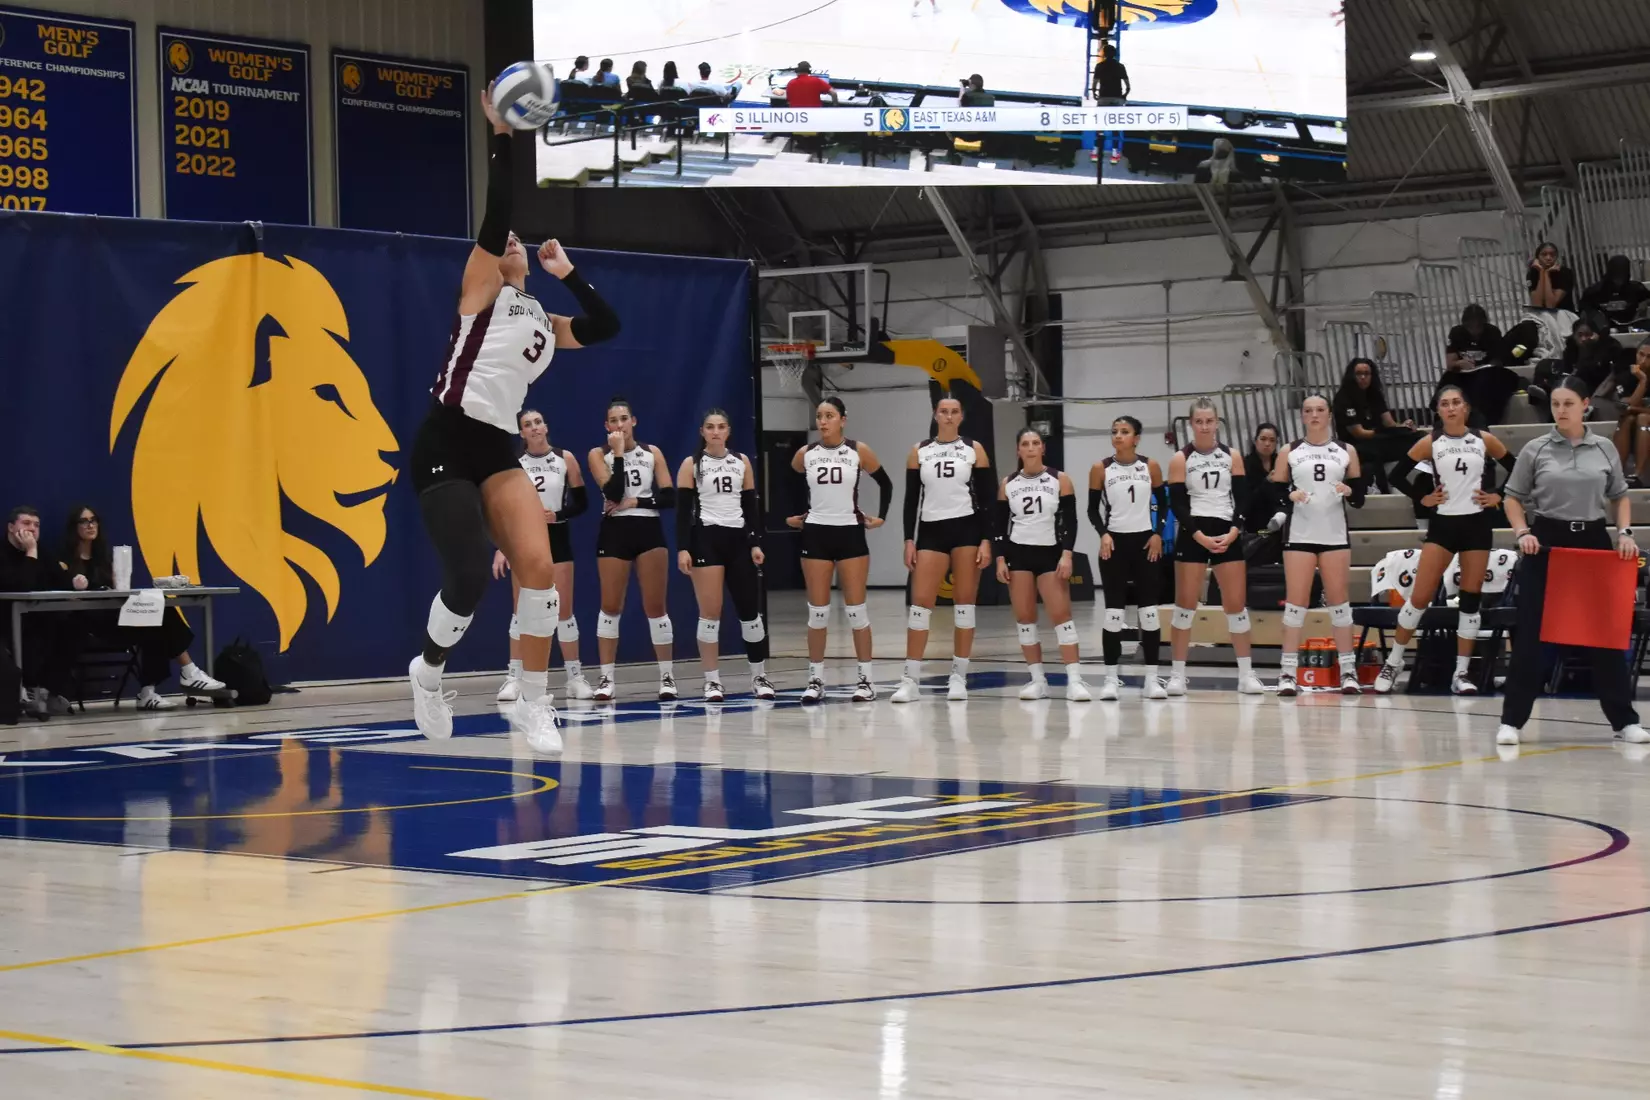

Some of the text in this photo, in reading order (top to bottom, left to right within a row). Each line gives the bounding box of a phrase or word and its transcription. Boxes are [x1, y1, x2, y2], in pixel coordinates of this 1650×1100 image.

[37, 24, 99, 46] MEN'S
[43, 40, 93, 59] GOLF
[208, 48, 293, 71] WOMEN'S
[46, 63, 126, 80] CHAMPIONSHIPS
[228, 65, 274, 82] GOLF
[376, 67, 453, 89] WOMEN'S
[171, 76, 300, 102] NCAA TOURNAMENT
[395, 83, 436, 99] GOLF
[174, 95, 230, 122] 2019
[341, 97, 462, 118] CONFERENCE CHAMPIONSHIPS
[913, 111, 997, 123] EAST TEXAS A&M
[735, 111, 808, 124] S ILLINOIS
[863, 112, 874, 127] 5
[1040, 111, 1050, 127] 8
[1062, 112, 1181, 127] SET 1 (BEST OF 5)
[174, 124, 230, 149] 2021
[175, 152, 236, 178] 2022
[522, 329, 547, 364] 3
[817, 466, 843, 485] 20
[934, 461, 955, 478] 15
[1313, 463, 1326, 482] 8
[1455, 457, 1468, 476] 4
[534, 475, 546, 493] 2
[624, 469, 642, 488] 13
[712, 475, 733, 493] 18
[1201, 470, 1220, 489] 17
[1127, 484, 1135, 503] 1
[1022, 495, 1042, 515] 21
[1303, 669, 1315, 683] G
[444, 796, 1032, 866] SLC
[594, 801, 1104, 871] SOUTHLAND
